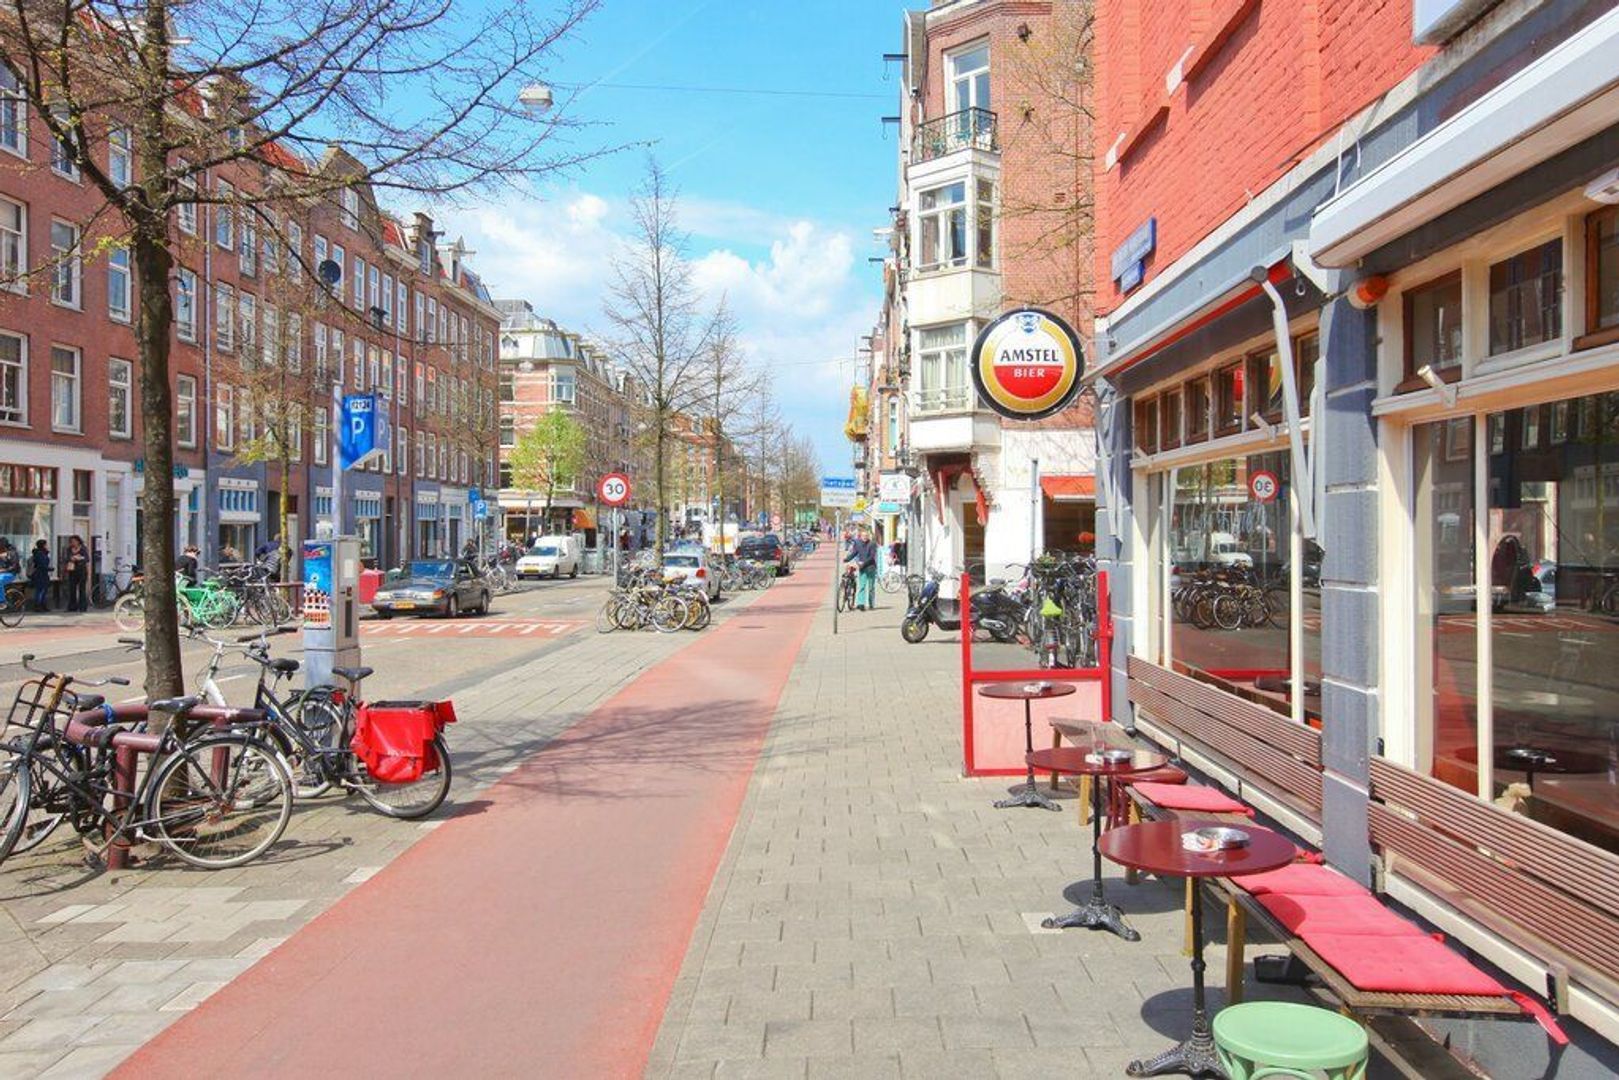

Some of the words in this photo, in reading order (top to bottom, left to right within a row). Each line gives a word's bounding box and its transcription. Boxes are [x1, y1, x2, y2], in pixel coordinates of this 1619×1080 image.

[1000, 349, 1059, 362] AMSTEL
[1013, 368, 1045, 378] BIER
[351, 417, 365, 444] P
[377, 418, 386, 441] P
[605, 483, 624, 495] 30
